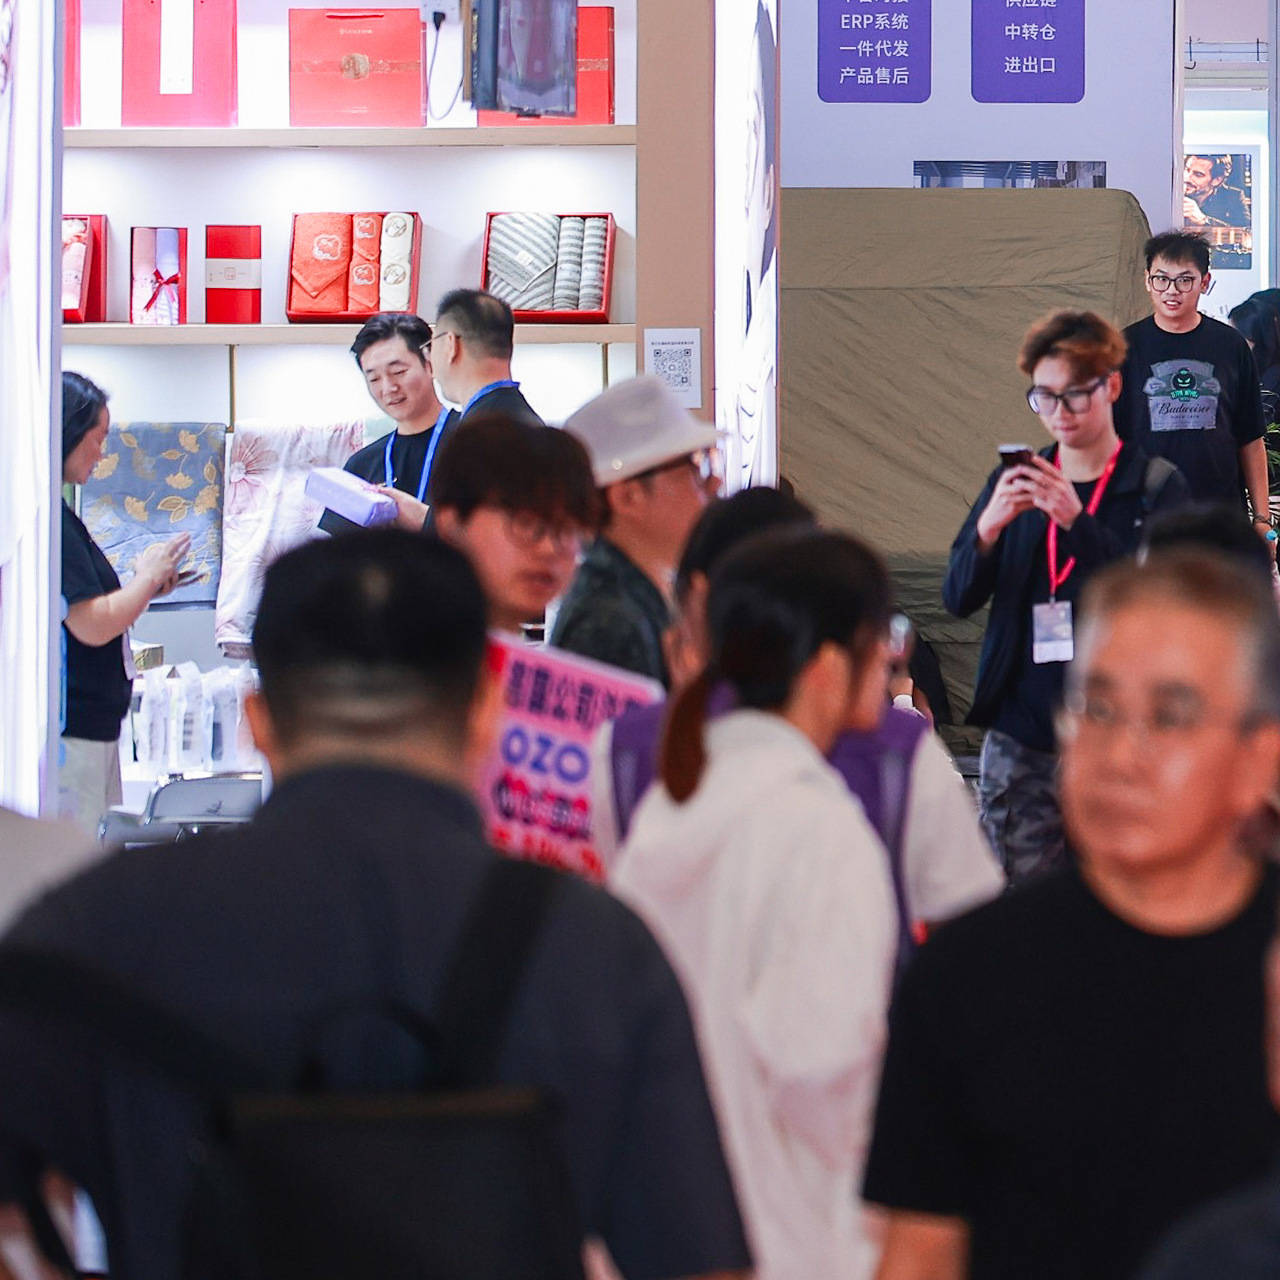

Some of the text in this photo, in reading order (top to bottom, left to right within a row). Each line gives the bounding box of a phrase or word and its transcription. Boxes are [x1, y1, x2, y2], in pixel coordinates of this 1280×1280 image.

[840, 13, 909, 31] ERP系统
[1004, 23, 1057, 41] 中转仓
[839, 40, 910, 59] 一件代发
[1004, 56, 1057, 74] 进出口
[839, 67, 910, 86] 产品售后
